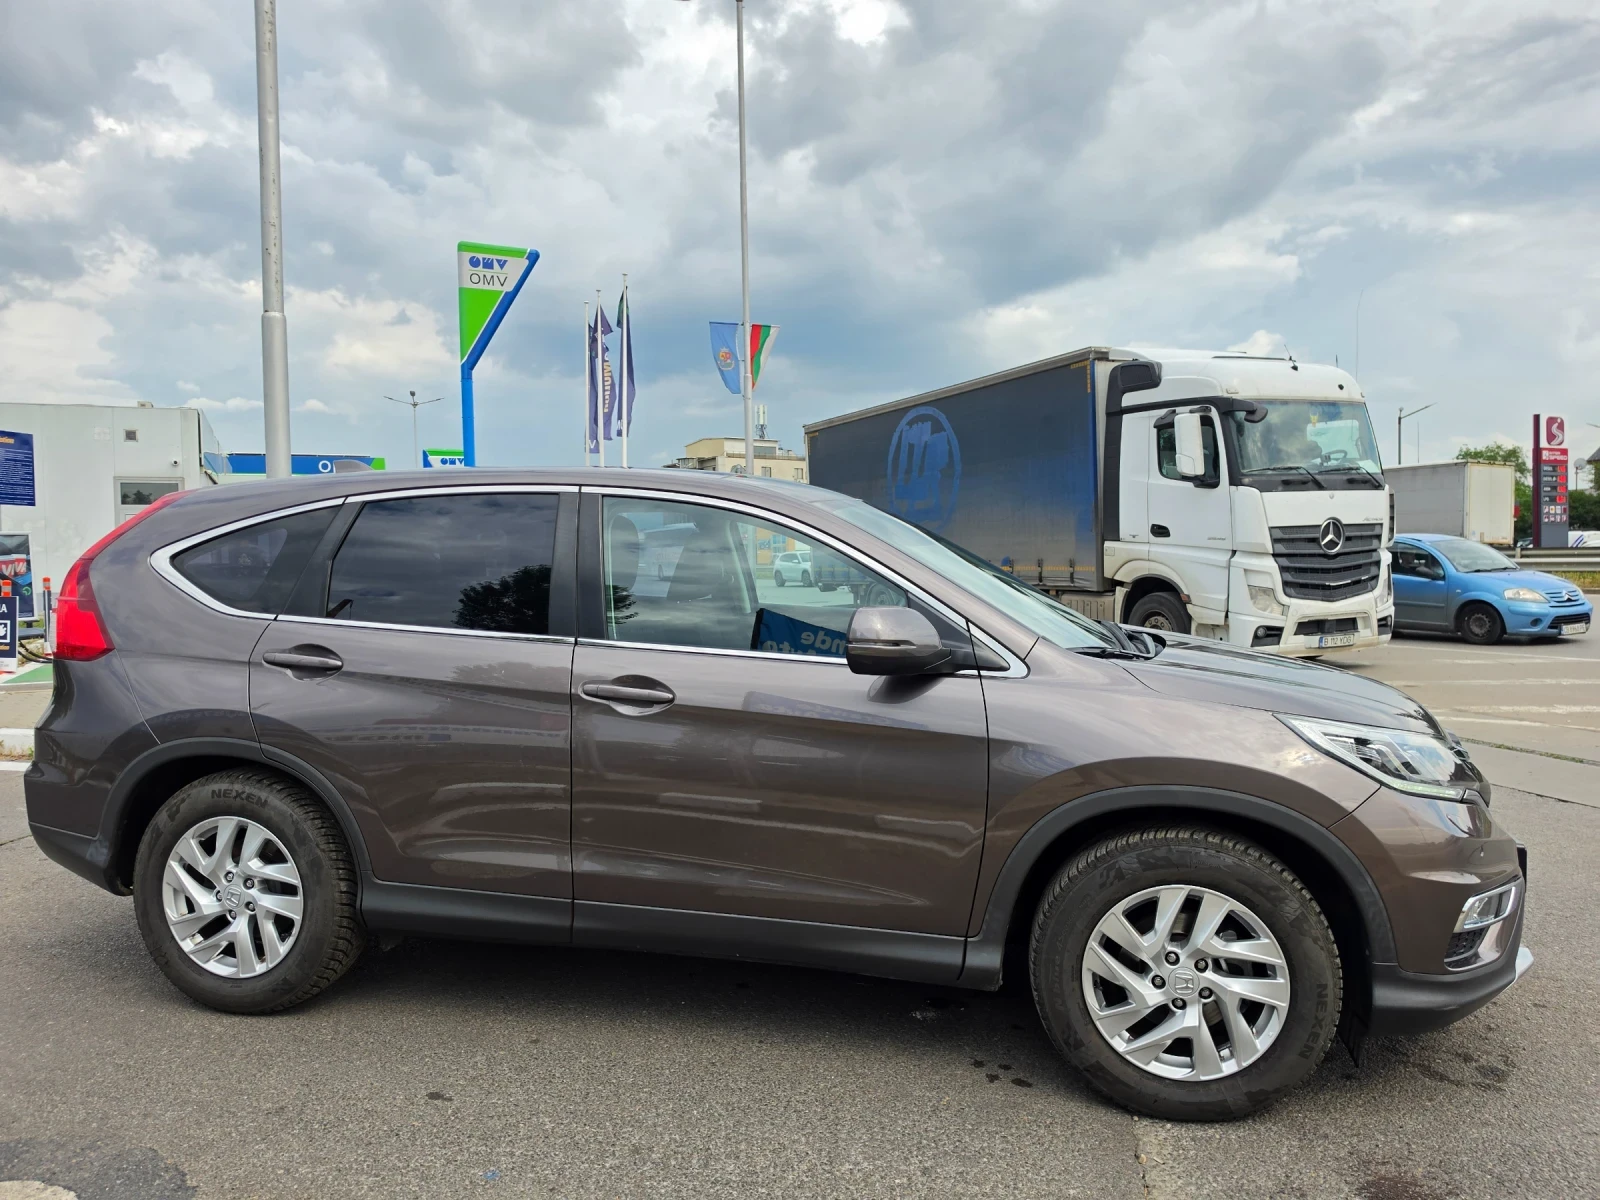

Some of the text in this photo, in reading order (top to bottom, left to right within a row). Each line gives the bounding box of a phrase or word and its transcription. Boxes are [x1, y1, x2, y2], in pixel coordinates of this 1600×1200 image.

[469, 272, 508, 287] OMV
[1324, 637, 1328, 646] B
[211, 788, 269, 809] NEXEN
[1298, 983, 1328, 1060] NEXEN
